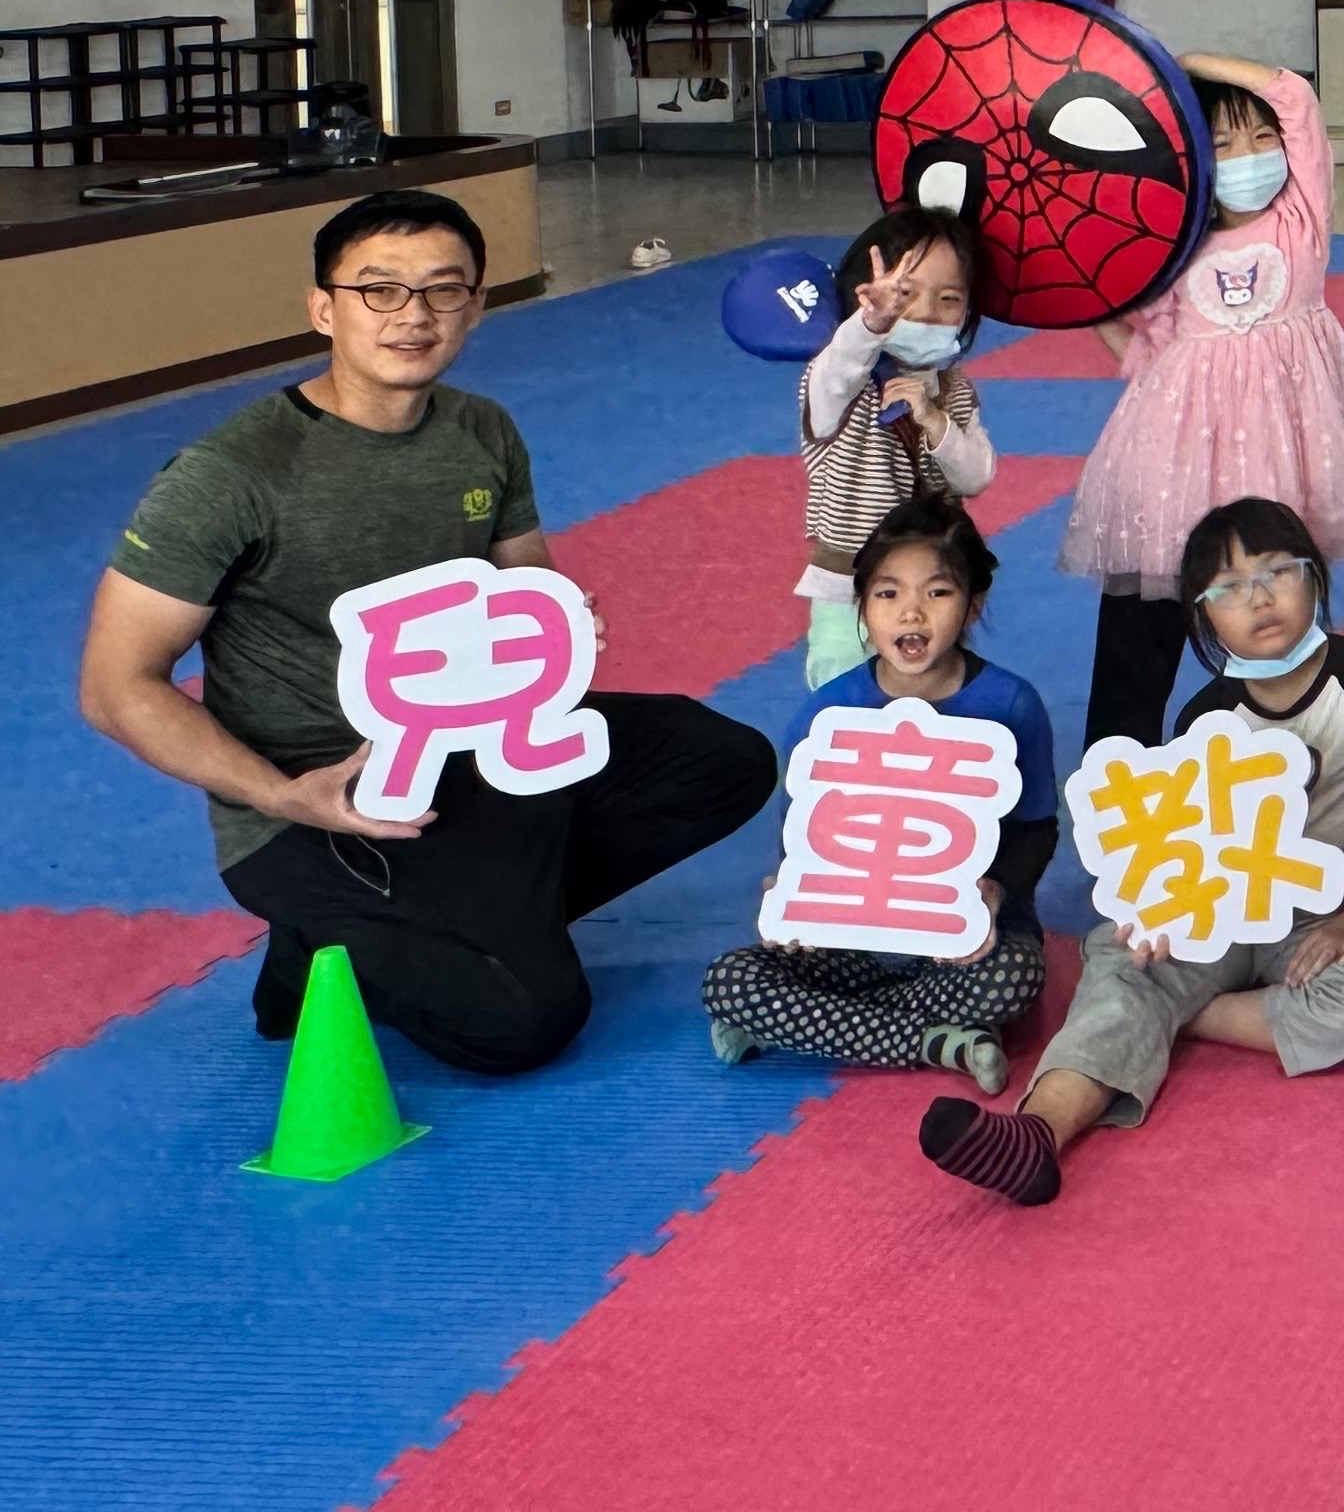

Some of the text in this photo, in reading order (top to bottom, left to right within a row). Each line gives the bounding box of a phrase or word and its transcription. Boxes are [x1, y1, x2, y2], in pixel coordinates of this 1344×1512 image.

[358, 579, 586, 798] 兒
[782, 719, 1000, 936] 童
[1088, 732, 1325, 942] 教
